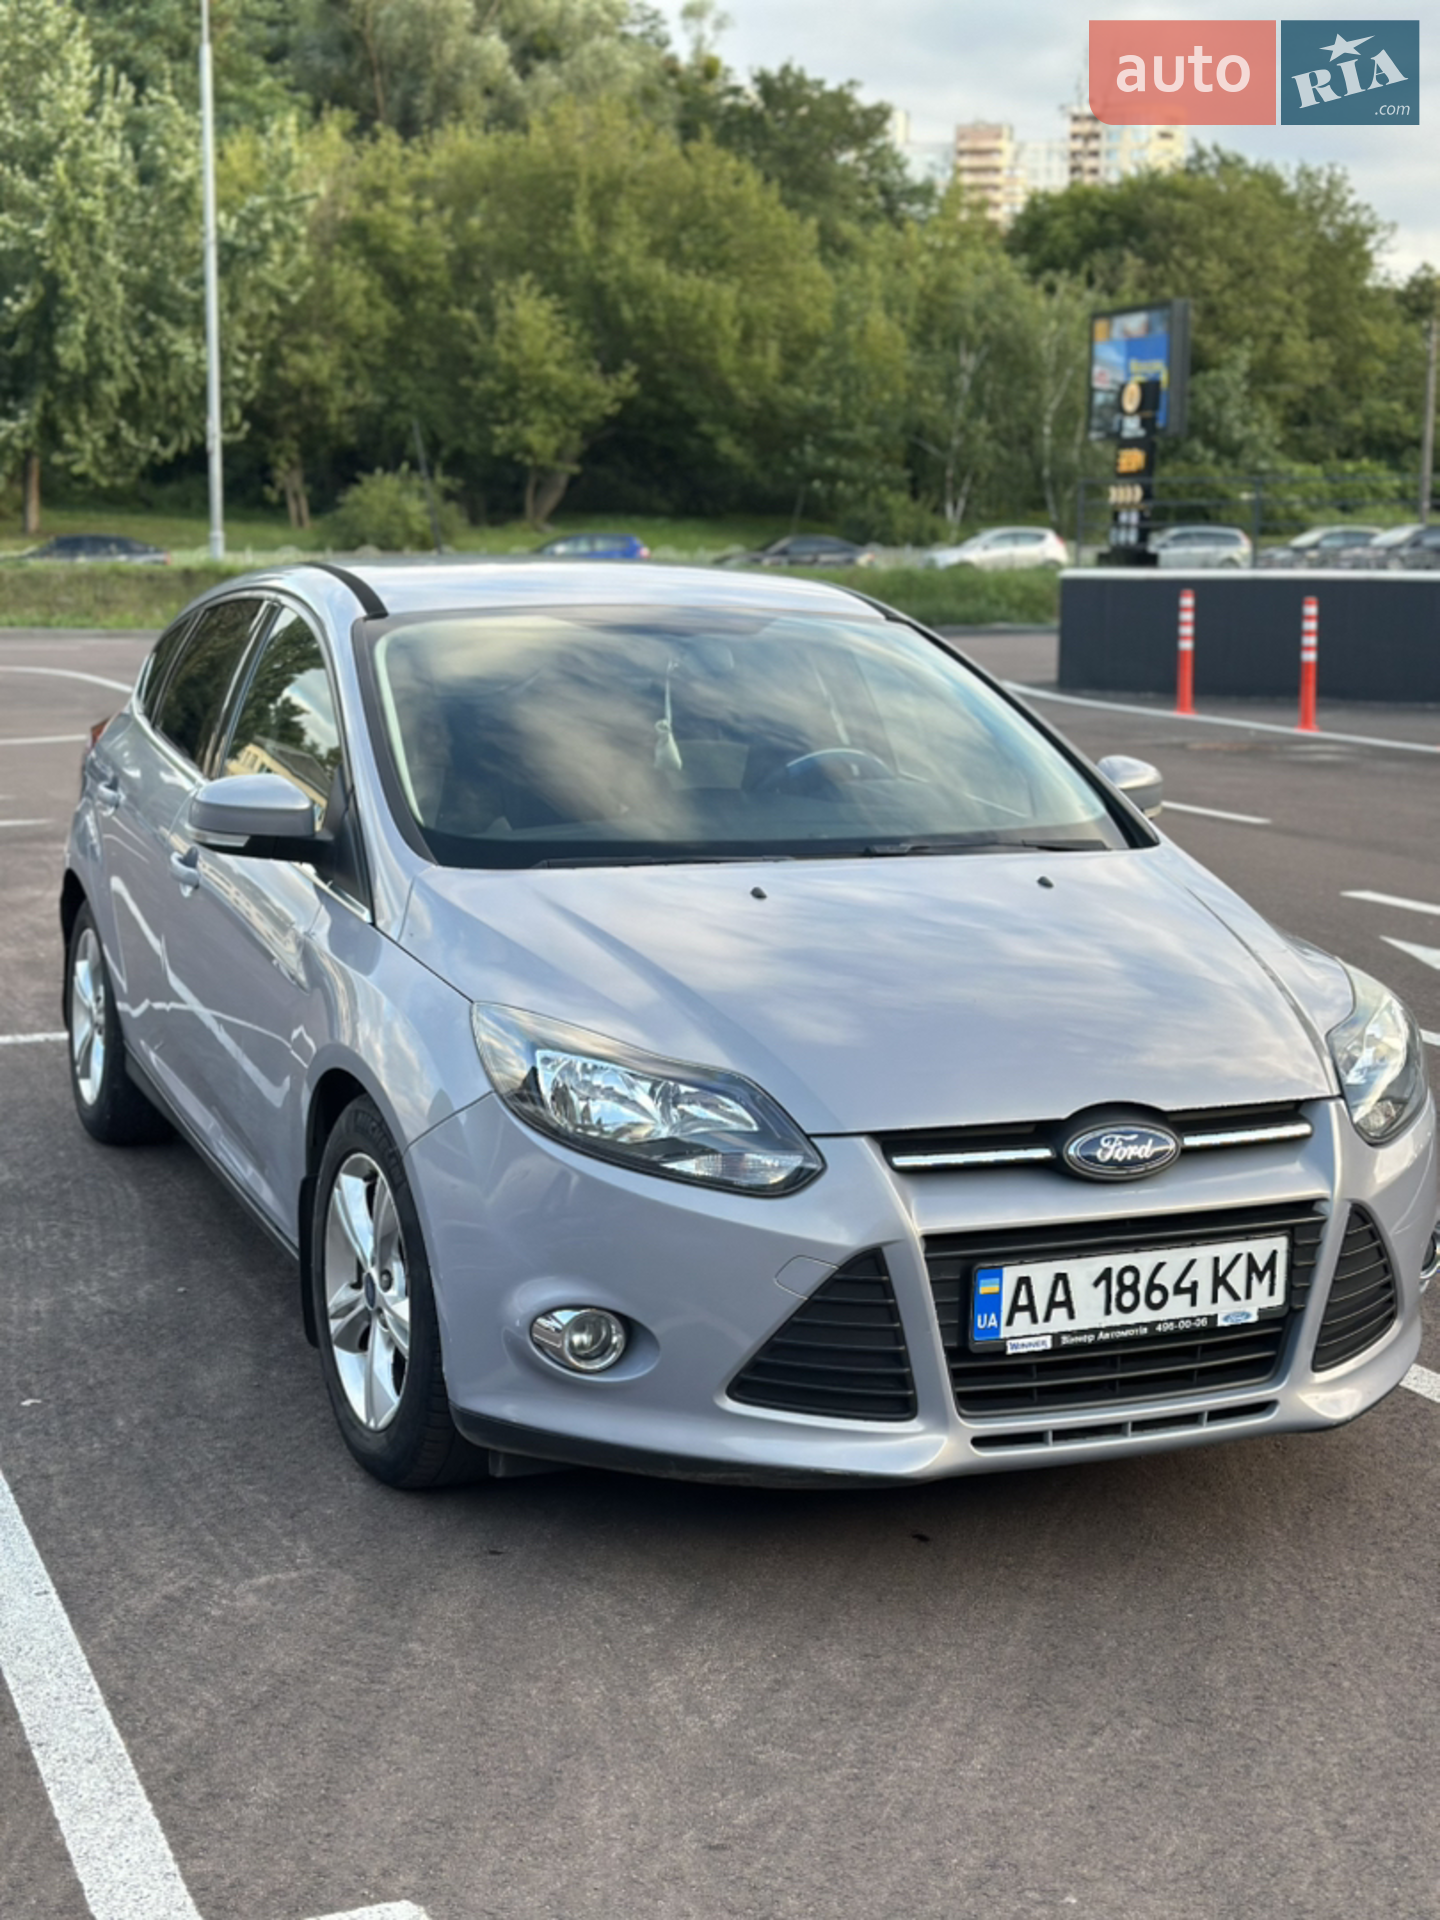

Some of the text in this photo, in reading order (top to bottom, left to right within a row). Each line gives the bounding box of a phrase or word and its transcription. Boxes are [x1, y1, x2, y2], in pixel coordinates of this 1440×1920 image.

[1096, 1133, 1154, 1163] Ford
[1005, 1249, 1279, 1327] AA 1864 KM
[977, 1313, 998, 1330] UA
